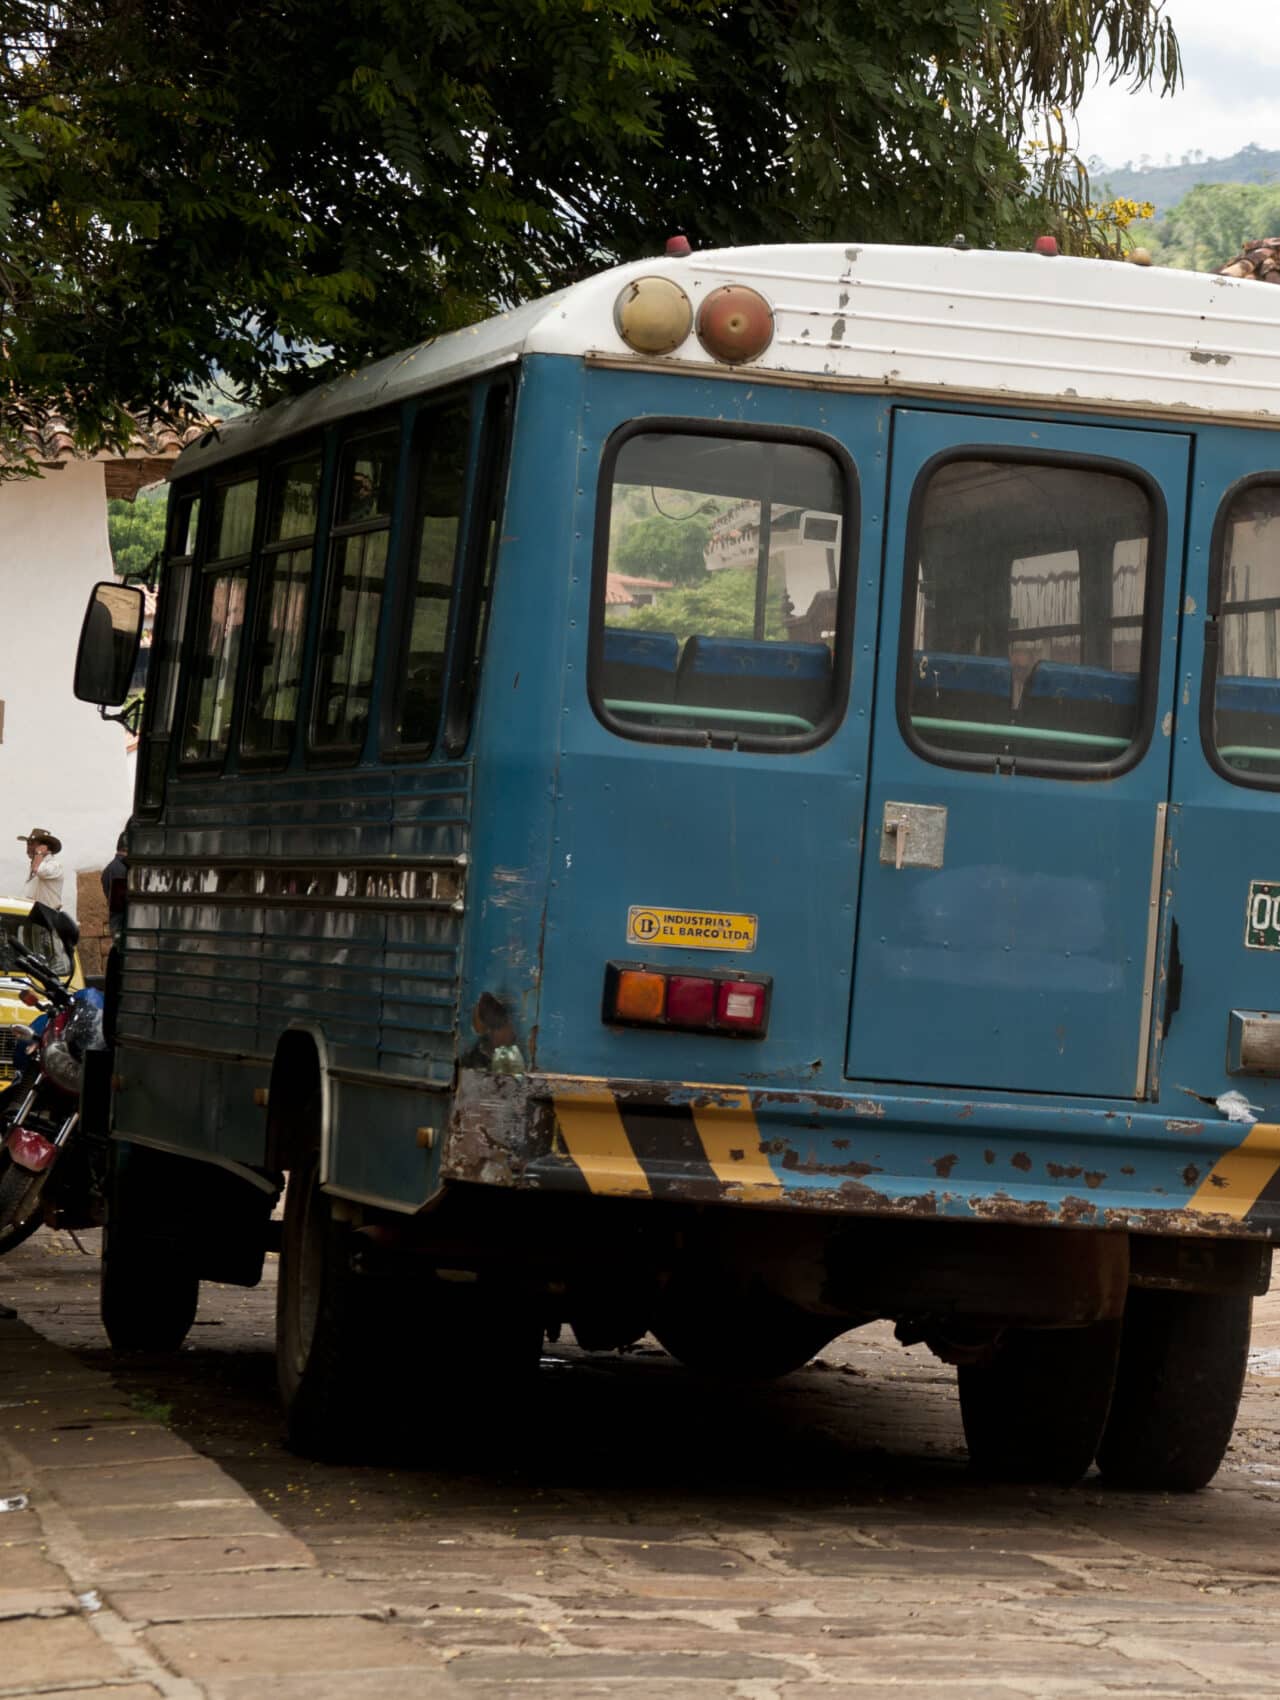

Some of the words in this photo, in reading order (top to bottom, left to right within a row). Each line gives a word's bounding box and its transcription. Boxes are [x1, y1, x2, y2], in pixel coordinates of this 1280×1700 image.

[663, 914, 732, 928] INDUSTRIAS
[663, 926, 675, 936] EL
[679, 927, 720, 938] BARCO
